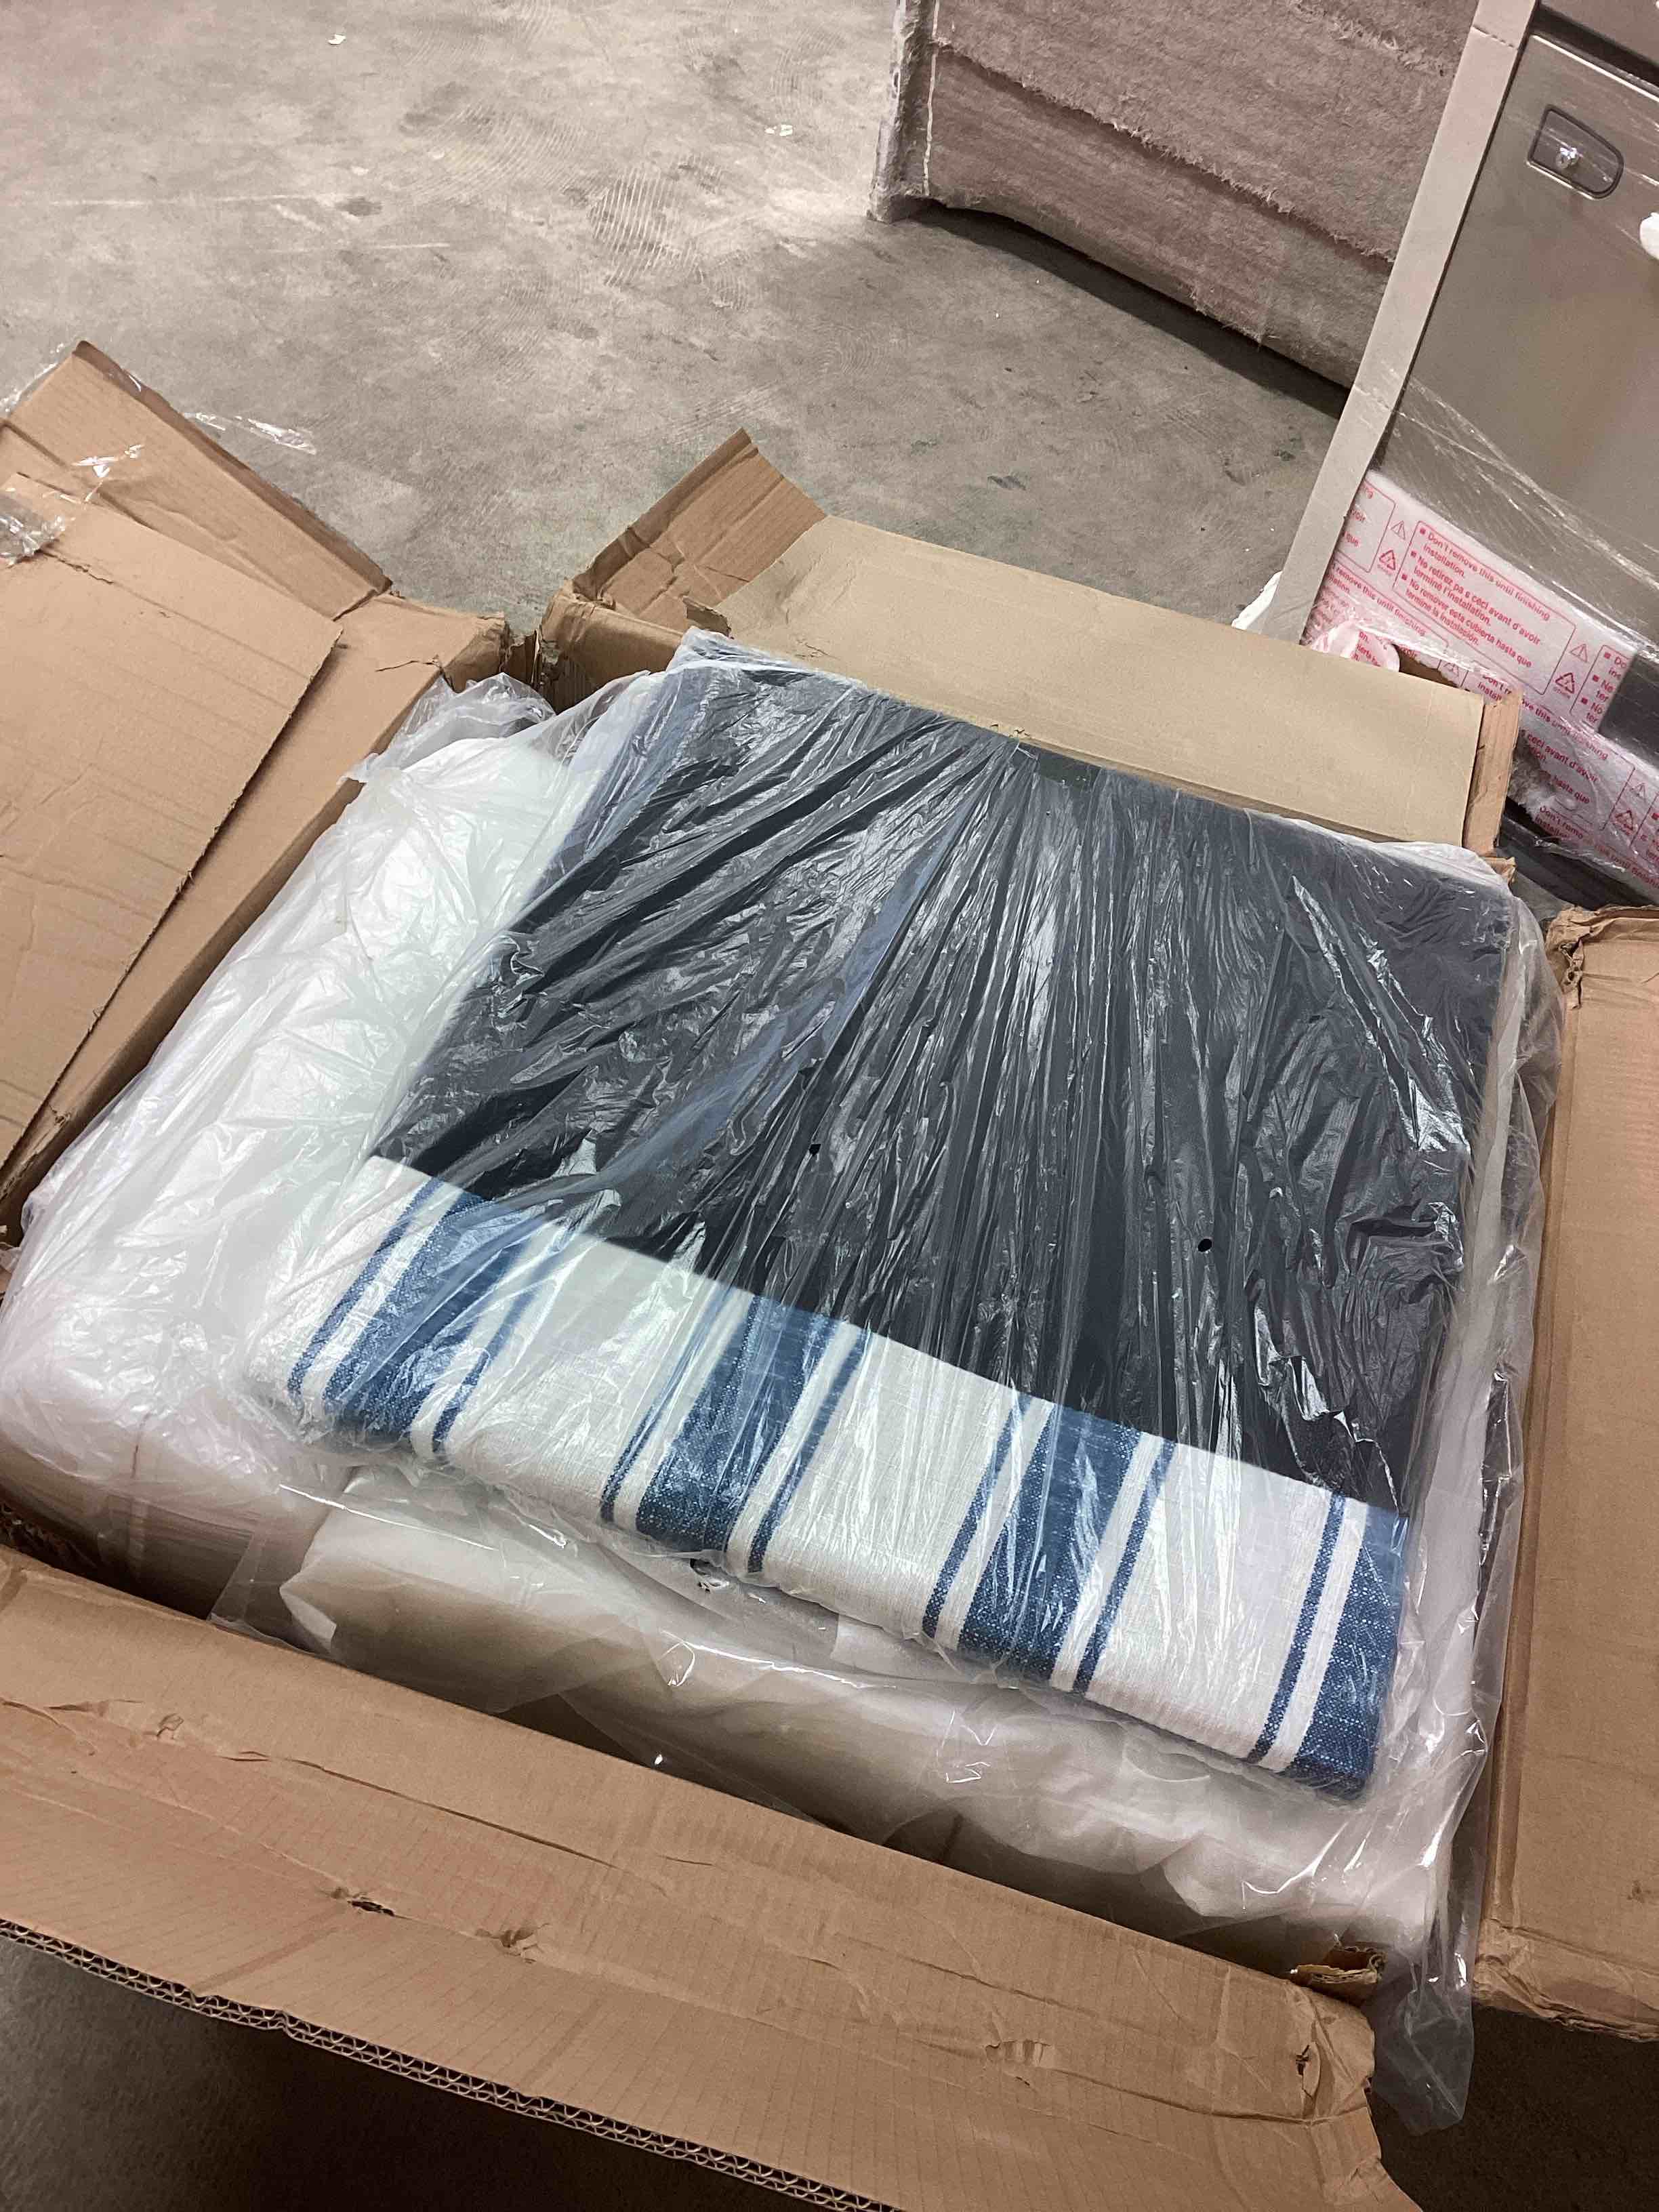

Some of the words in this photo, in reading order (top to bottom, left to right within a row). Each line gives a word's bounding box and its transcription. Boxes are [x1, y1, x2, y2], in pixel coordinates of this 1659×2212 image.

[1336, 567, 1361, 589] remove
[1376, 598, 1394, 612] until
[1428, 531, 1448, 552] Don't
[1449, 548, 1477, 572] remove
[1479, 568, 1494, 582] this
[1496, 580, 1514, 596] until
[1515, 590, 1551, 621] finishing
[1406, 588, 1432, 612] termine
[1432, 606, 1439, 617] la
[1429, 565, 1453, 586] retirez
[1471, 595, 1489, 609] ceci
[1488, 607, 1512, 626] avant
[1512, 621, 1540, 645] d'avoir
[1410, 578, 1420, 591] No
[1420, 588, 1449, 610] remover
[1449, 609, 1465, 623] esta
[1465, 619, 1495, 644] cubierta
[1495, 637, 1517, 658] hasta
[1517, 654, 1532, 668] que
[1535, 708, 1551, 722] this
[1590, 702, 1603, 714] No
[1528, 733, 1545, 748] ceci
[1544, 745, 1569, 765] avant
[1574, 790, 1590, 804] que
